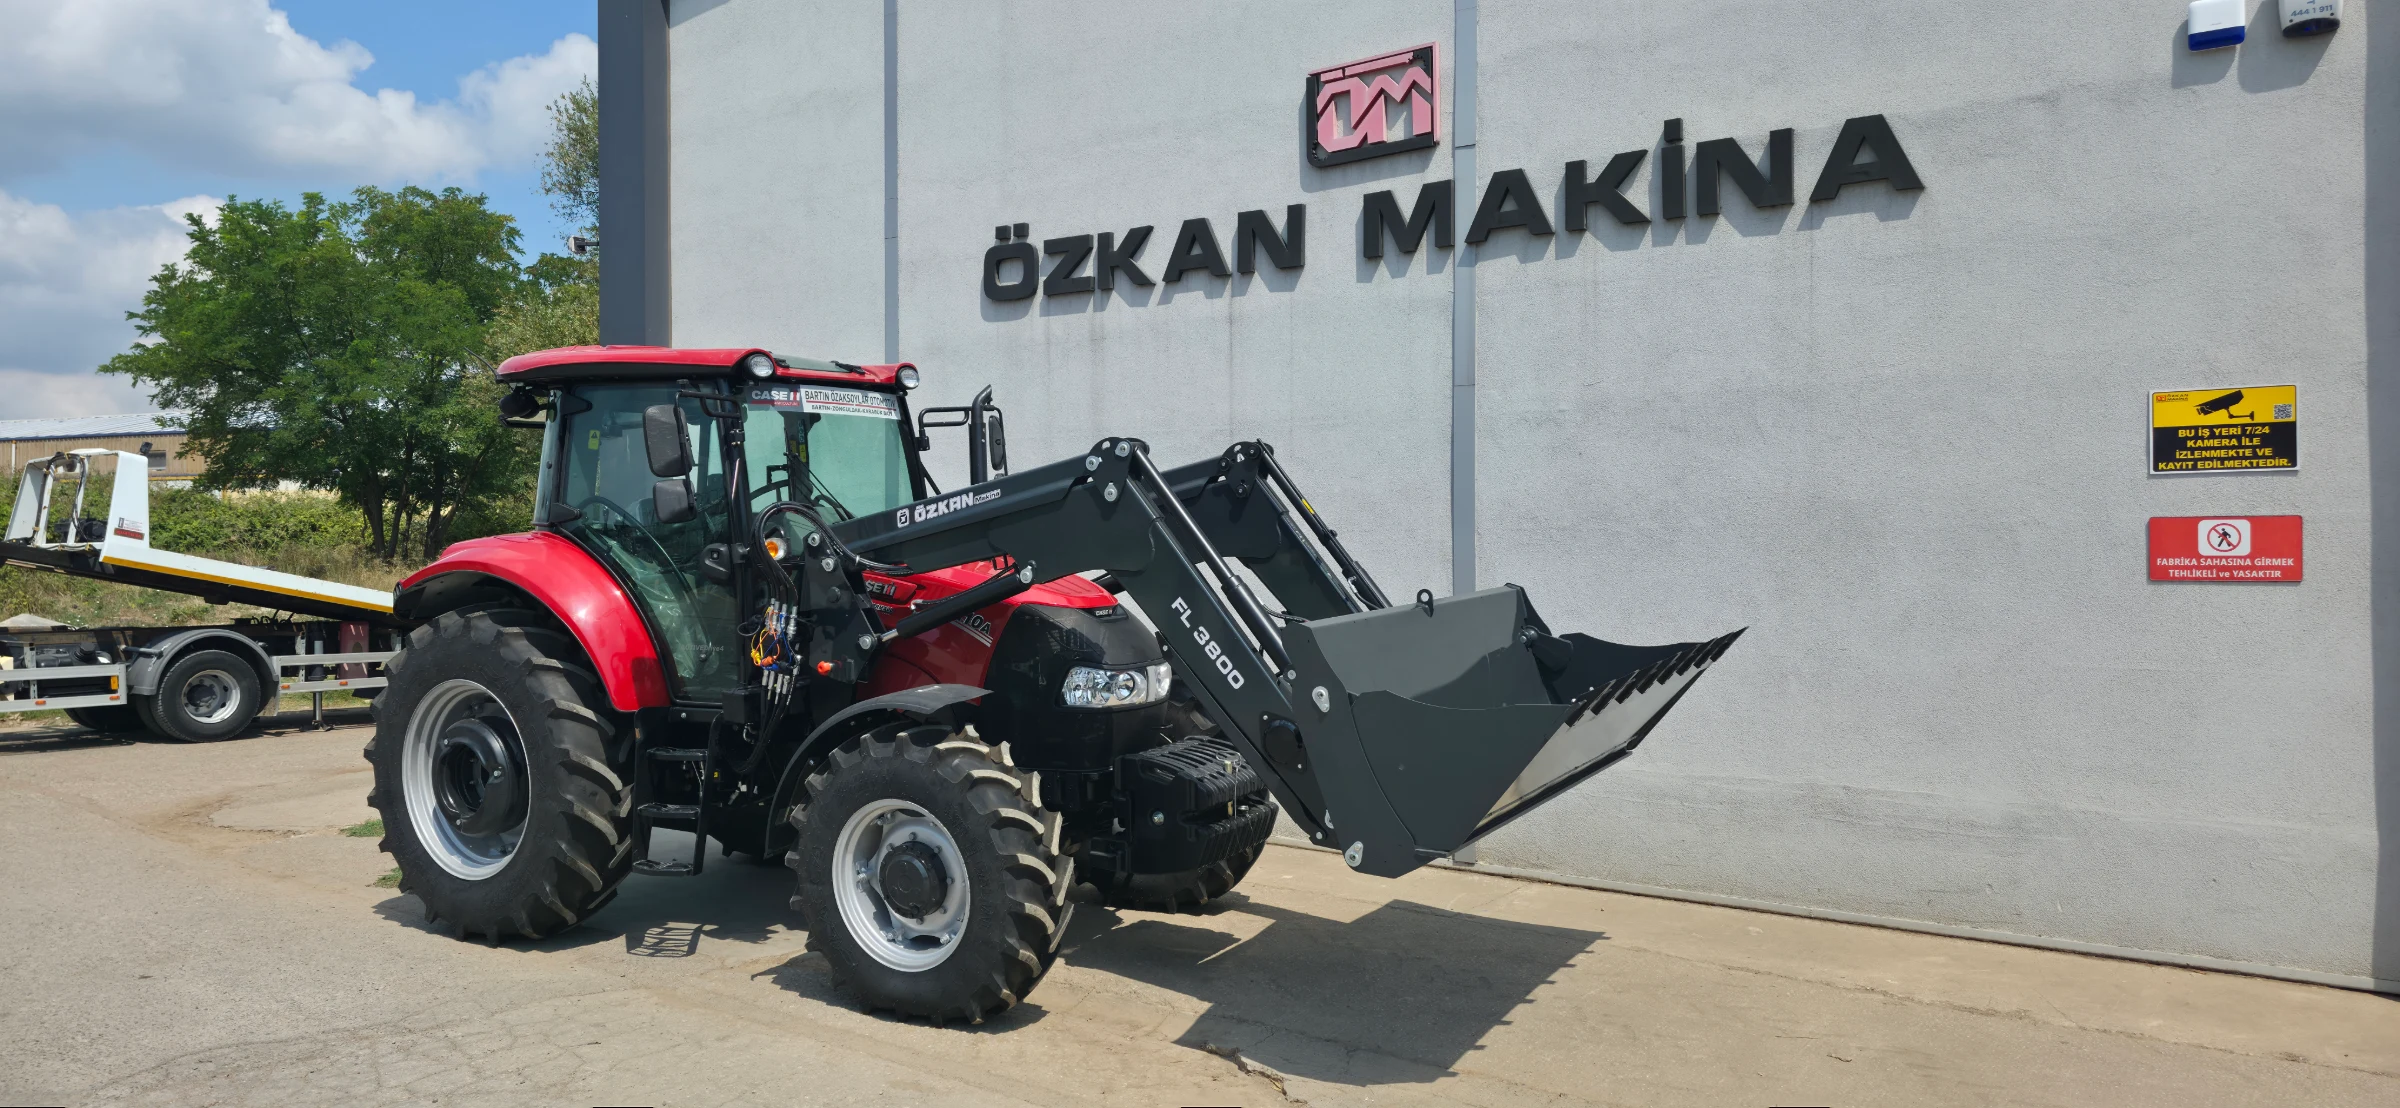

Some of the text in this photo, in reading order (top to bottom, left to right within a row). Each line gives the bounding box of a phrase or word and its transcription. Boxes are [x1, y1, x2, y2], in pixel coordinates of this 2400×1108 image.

[2290, 8, 2310, 17] 444
[2319, 4, 2333, 13] 911
[983, 113, 1925, 301] ÖZKAN MAKİNA
[751, 390, 788, 400] CASE
[804, 390, 830, 401] BARTIN
[2178, 425, 2270, 439] BU İŞ YERİ 7/24
[2187, 437, 2261, 448] KAMERA İLE
[2176, 447, 2273, 459] İZLENMEKTE VE
[2158, 457, 2292, 470] KAYIT EDİLMEKTEDİR.
[914, 492, 974, 523] ÖZKAN
[2156, 556, 2294, 566] FABRİKA SAHASINA GİRMEK
[2168, 568, 2217, 578] TEHLİKELİ
[2232, 569, 2282, 578] YASAKTIR
[960, 611, 993, 635] 10A
[1171, 596, 1245, 690] FL 3800
